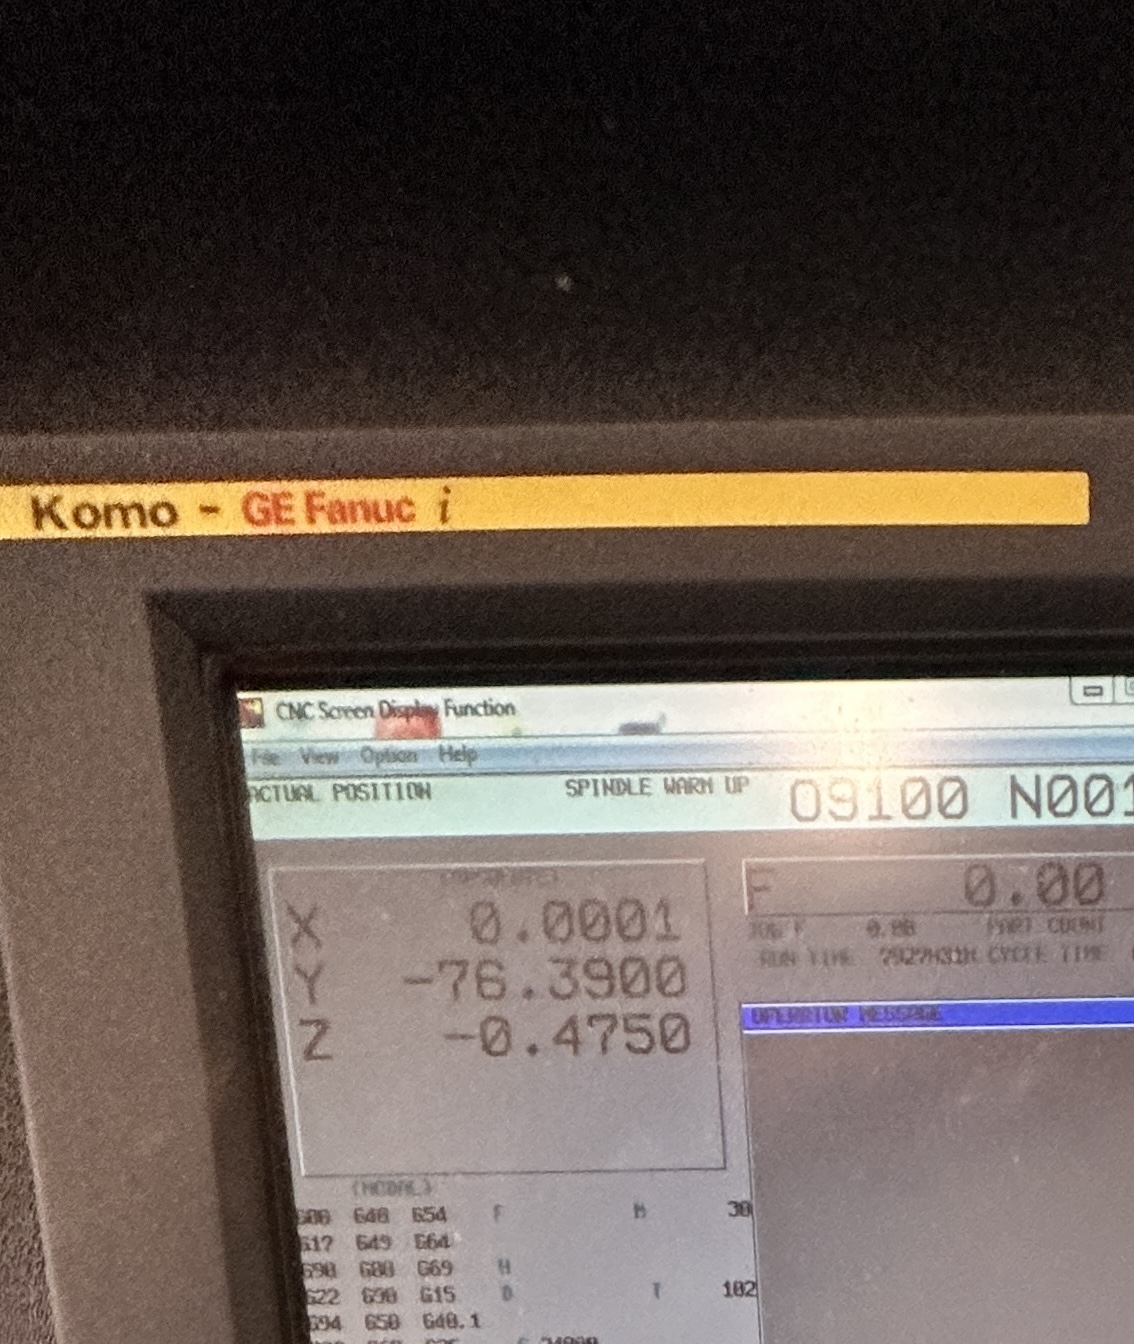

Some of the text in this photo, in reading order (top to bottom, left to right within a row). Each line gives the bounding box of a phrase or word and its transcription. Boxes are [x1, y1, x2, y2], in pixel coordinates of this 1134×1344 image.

[31, 494, 181, 531] Komo
[242, 491, 296, 527] GE
[304, 489, 416, 525] Fanuc
[439, 486, 452, 525] i
[276, 698, 516, 723] CNC Screen Display Function
[332, 782, 432, 802] POSITION
[565, 775, 750, 797] SPINDLE WARM UP
[286, 898, 682, 948] X 0.0001
[294, 955, 688, 1005] Y -76.3900
[299, 1012, 693, 1061] Z -0.4750
